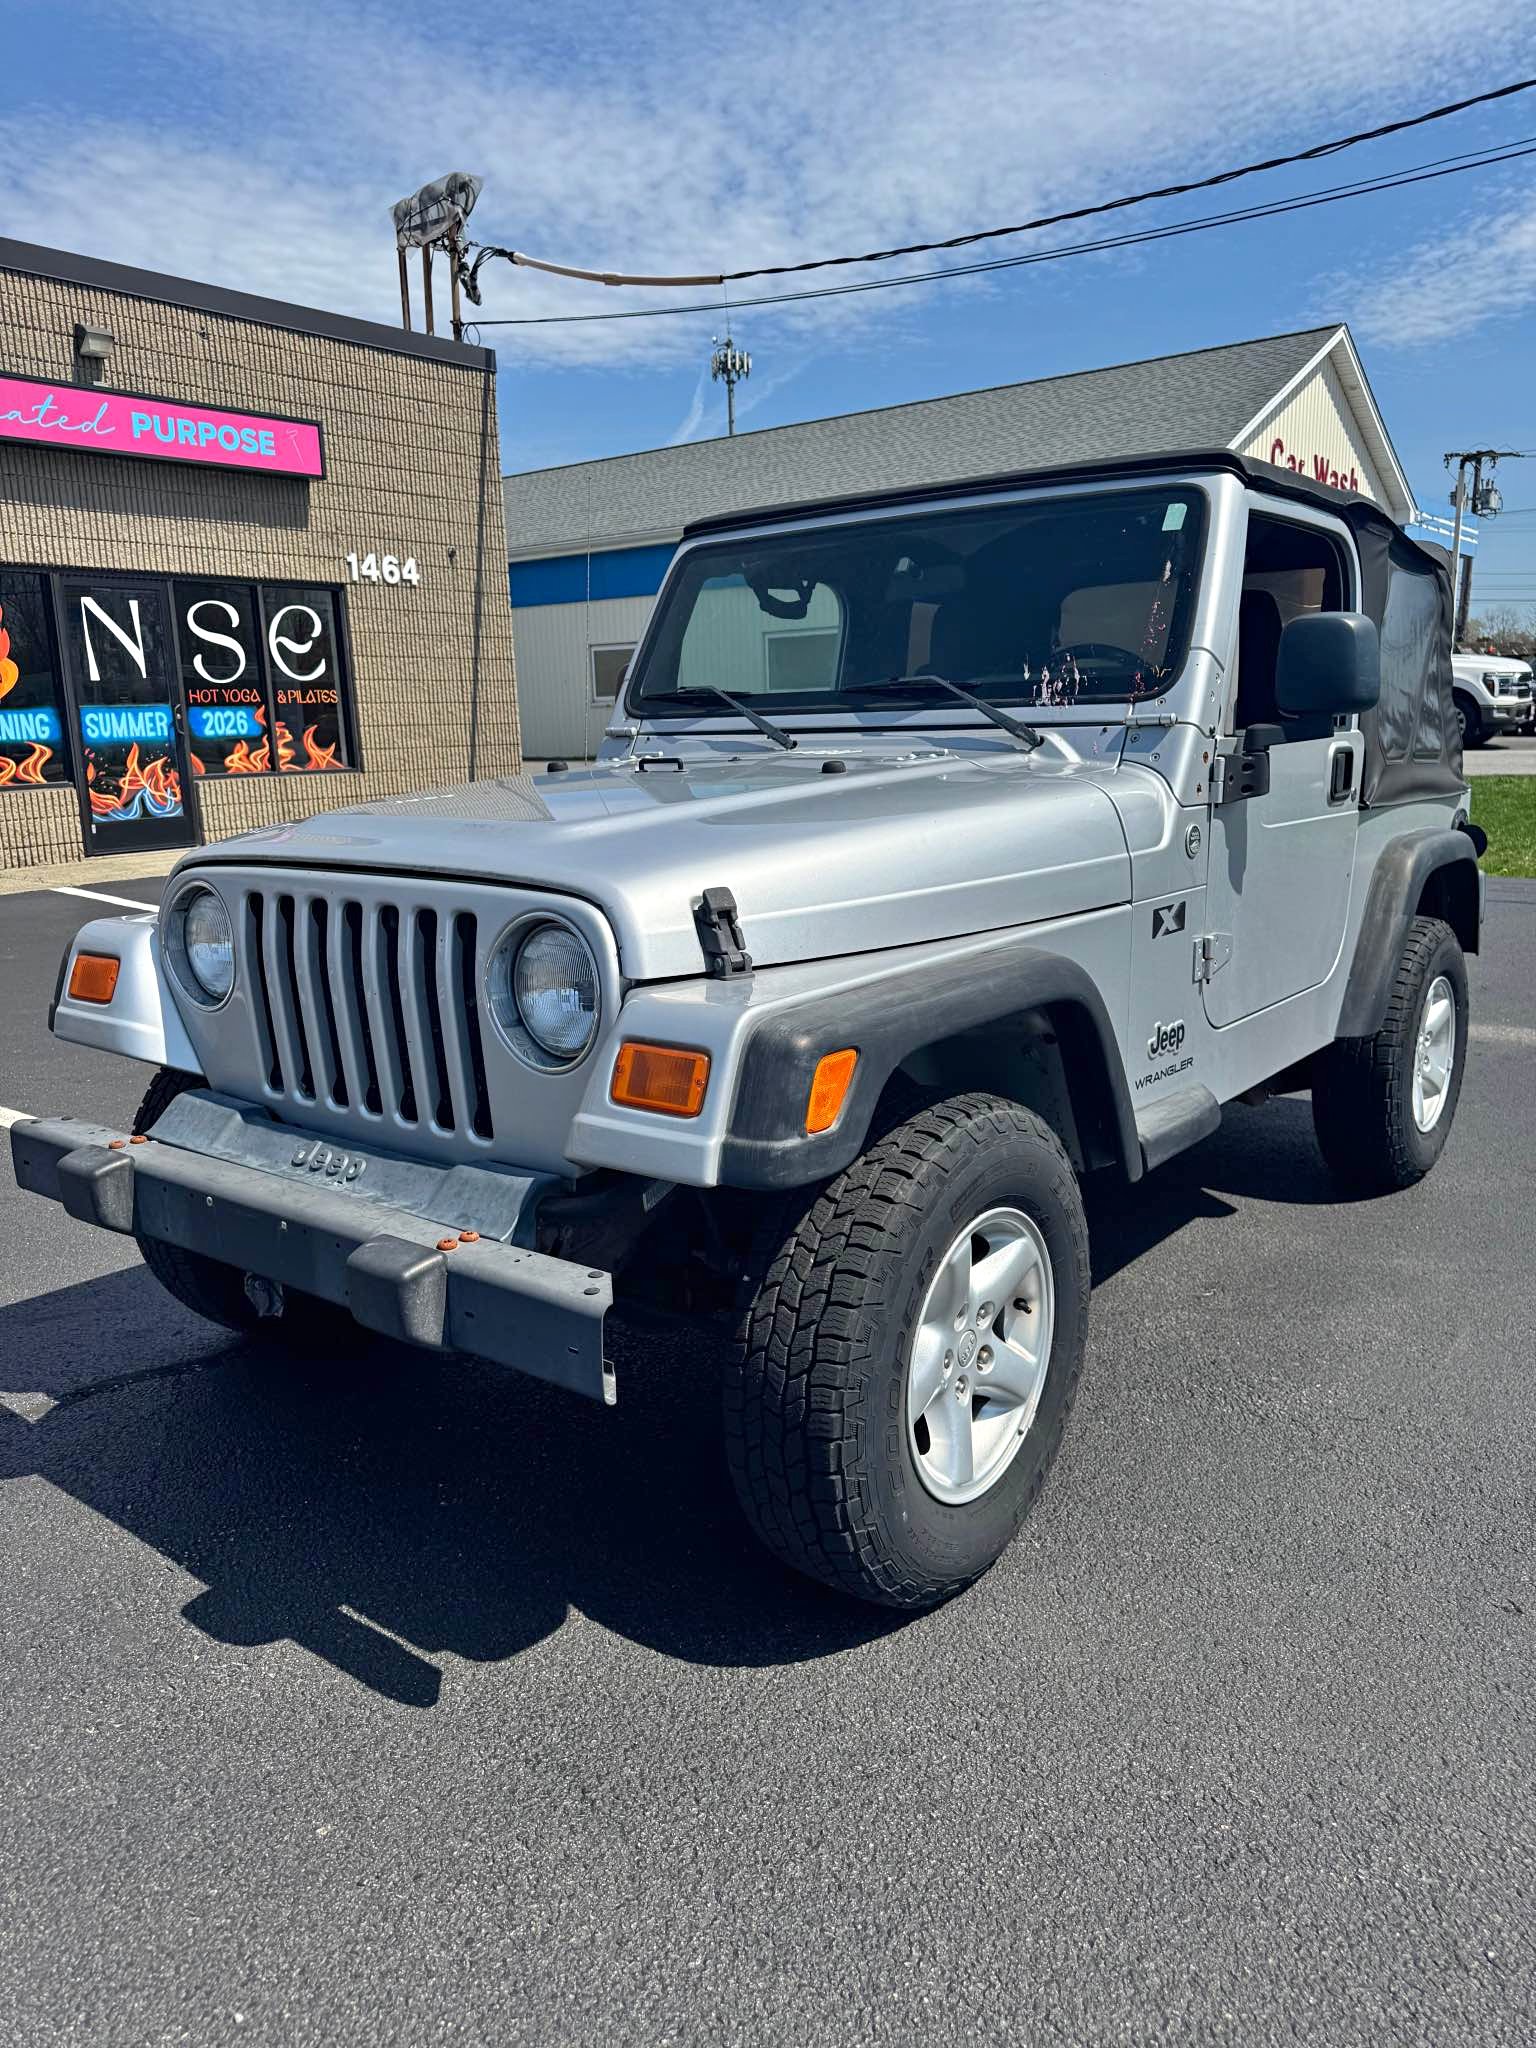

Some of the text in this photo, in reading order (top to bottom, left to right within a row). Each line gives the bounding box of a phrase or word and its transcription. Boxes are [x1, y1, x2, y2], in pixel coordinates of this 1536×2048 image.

[0, 394, 276, 456] ated PURPOSE
[1271, 438, 1358, 492] Car Wash
[346, 552, 420, 586] 1464
[188, 689, 218, 704] HOT
[222, 689, 261, 704] YOGA
[0, 710, 248, 741] NING SUMMER 2026
[1152, 901, 1186, 939] X
[1148, 1020, 1185, 1058] Jeep
[1135, 1057, 1194, 1090] WRANGLER
[291, 1141, 367, 1187] Jeep
